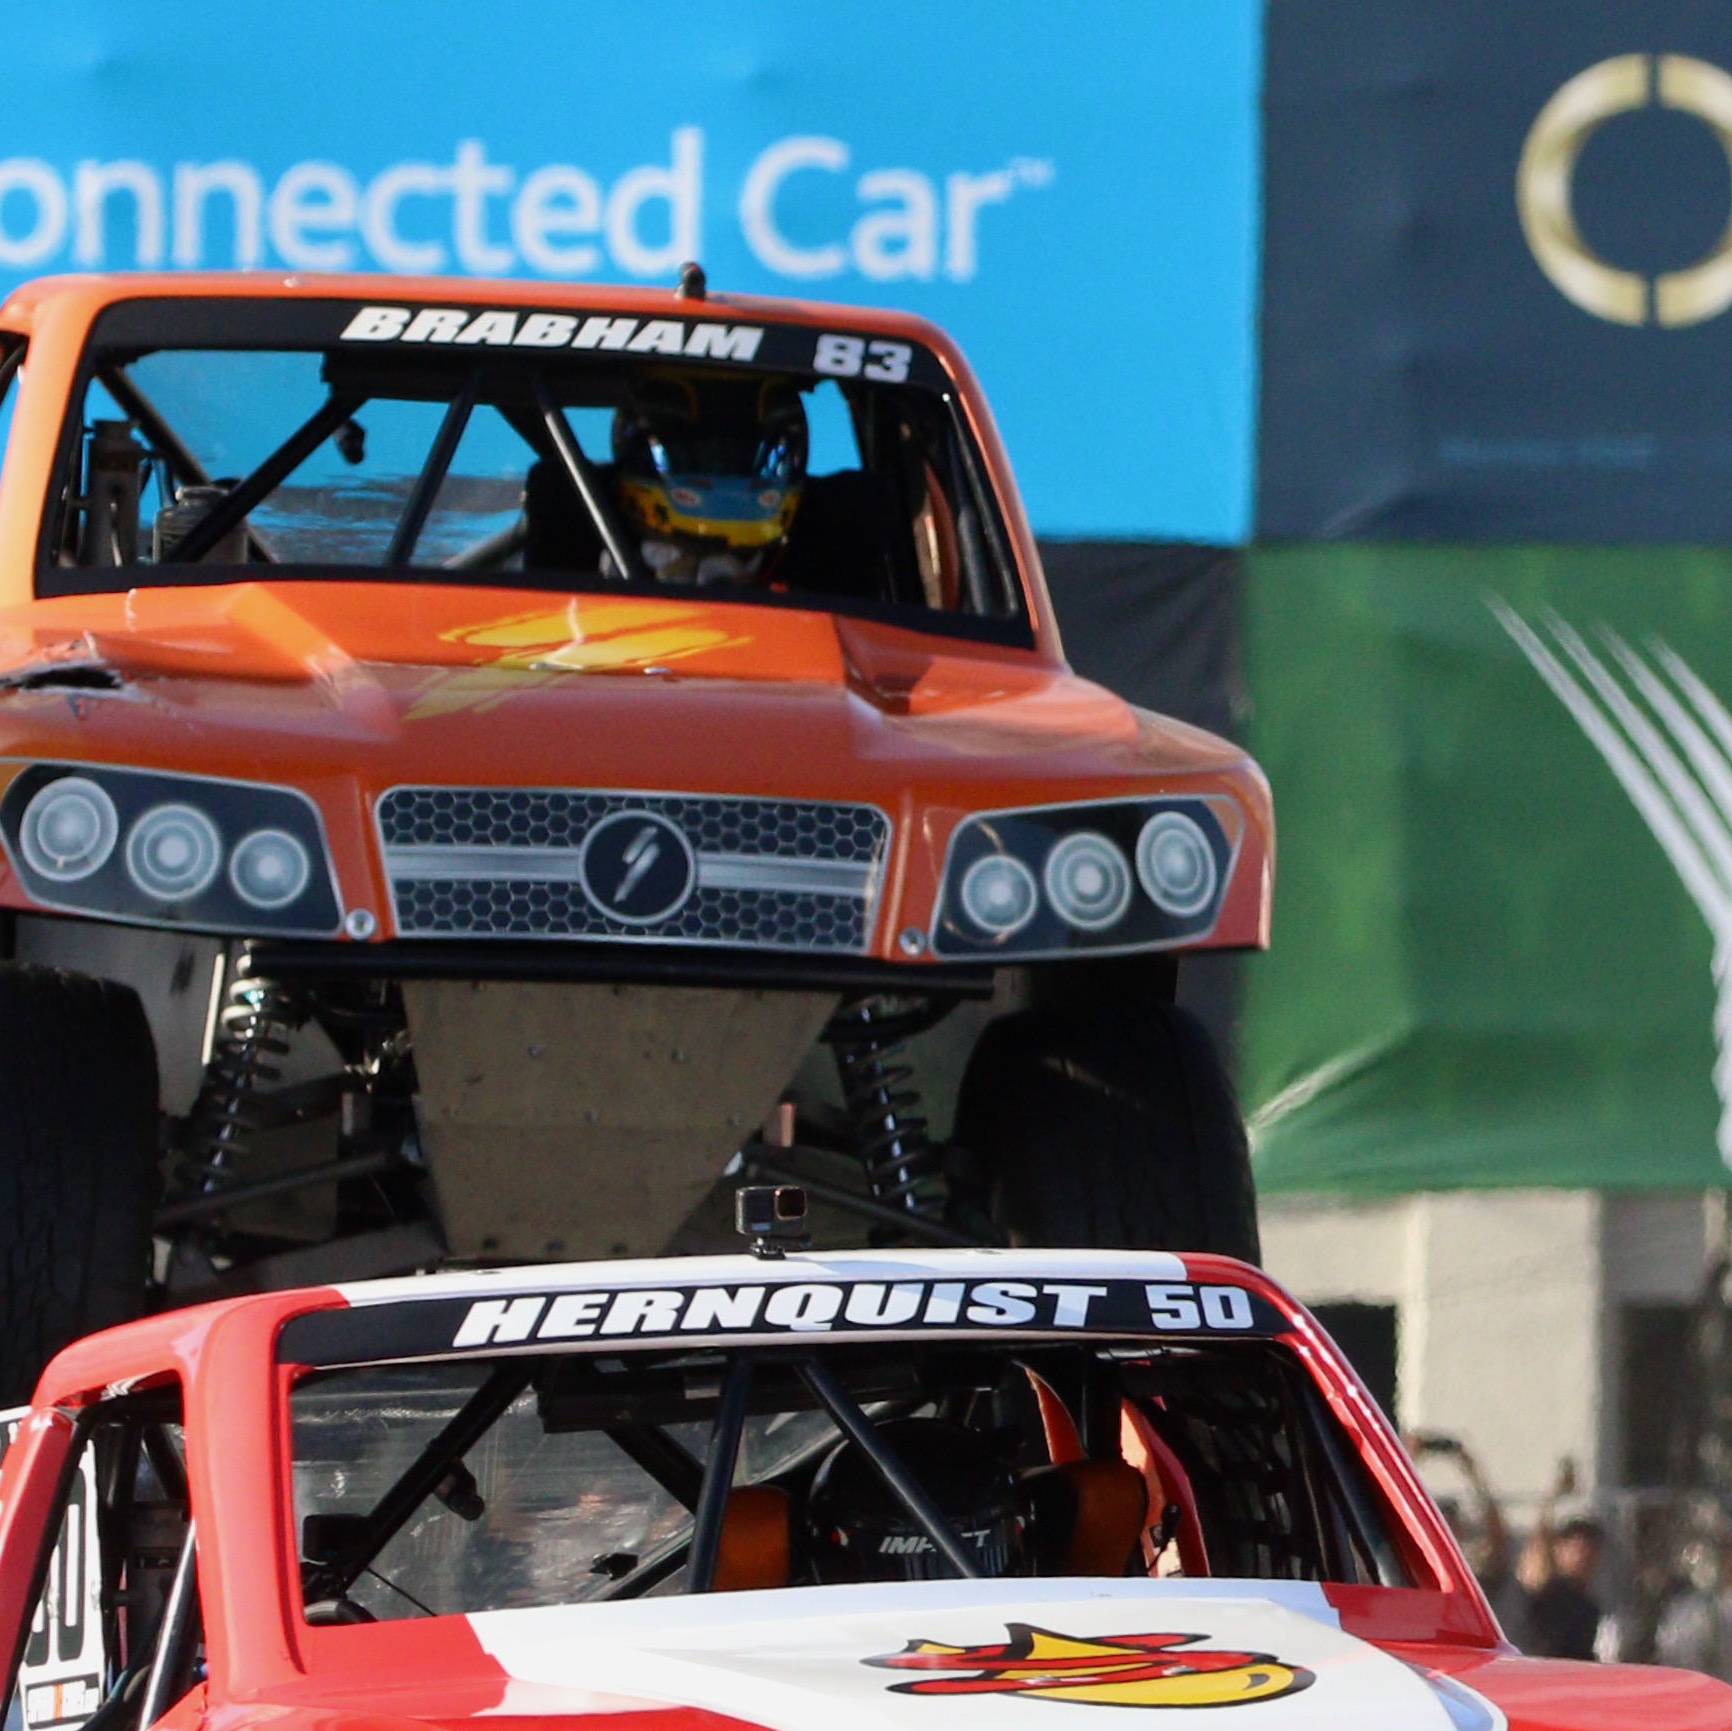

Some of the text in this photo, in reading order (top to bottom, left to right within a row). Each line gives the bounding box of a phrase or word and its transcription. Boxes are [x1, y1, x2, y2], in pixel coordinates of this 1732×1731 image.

[340, 306, 913, 385] BRABHAM 83
[452, 1281, 1255, 1349] HERNQUIST 50
